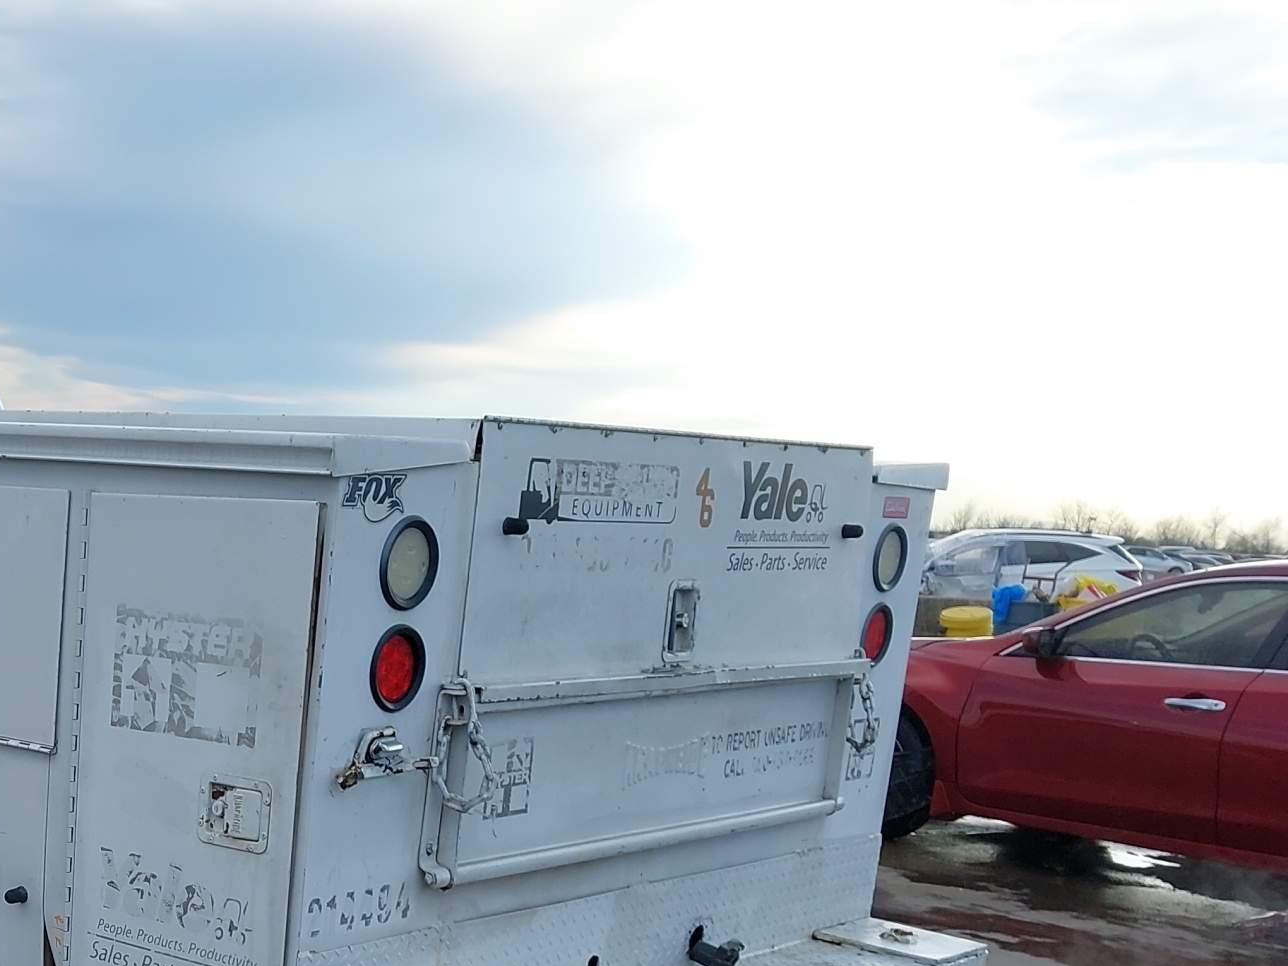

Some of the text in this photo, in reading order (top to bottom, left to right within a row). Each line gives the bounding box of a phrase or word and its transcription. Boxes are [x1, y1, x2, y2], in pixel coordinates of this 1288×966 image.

[342, 474, 407, 508] FOX
[740, 461, 809, 522] Yale
[571, 498, 664, 519] EQUIPMENT
[726, 551, 828, 572] Sales Parts Service
[726, 729, 761, 752] REPORT
[764, 725, 798, 747] UNSAFE
[97, 917, 133, 939] People.
[137, 928, 184, 953] Products.
[89, 940, 129, 966] Sales
